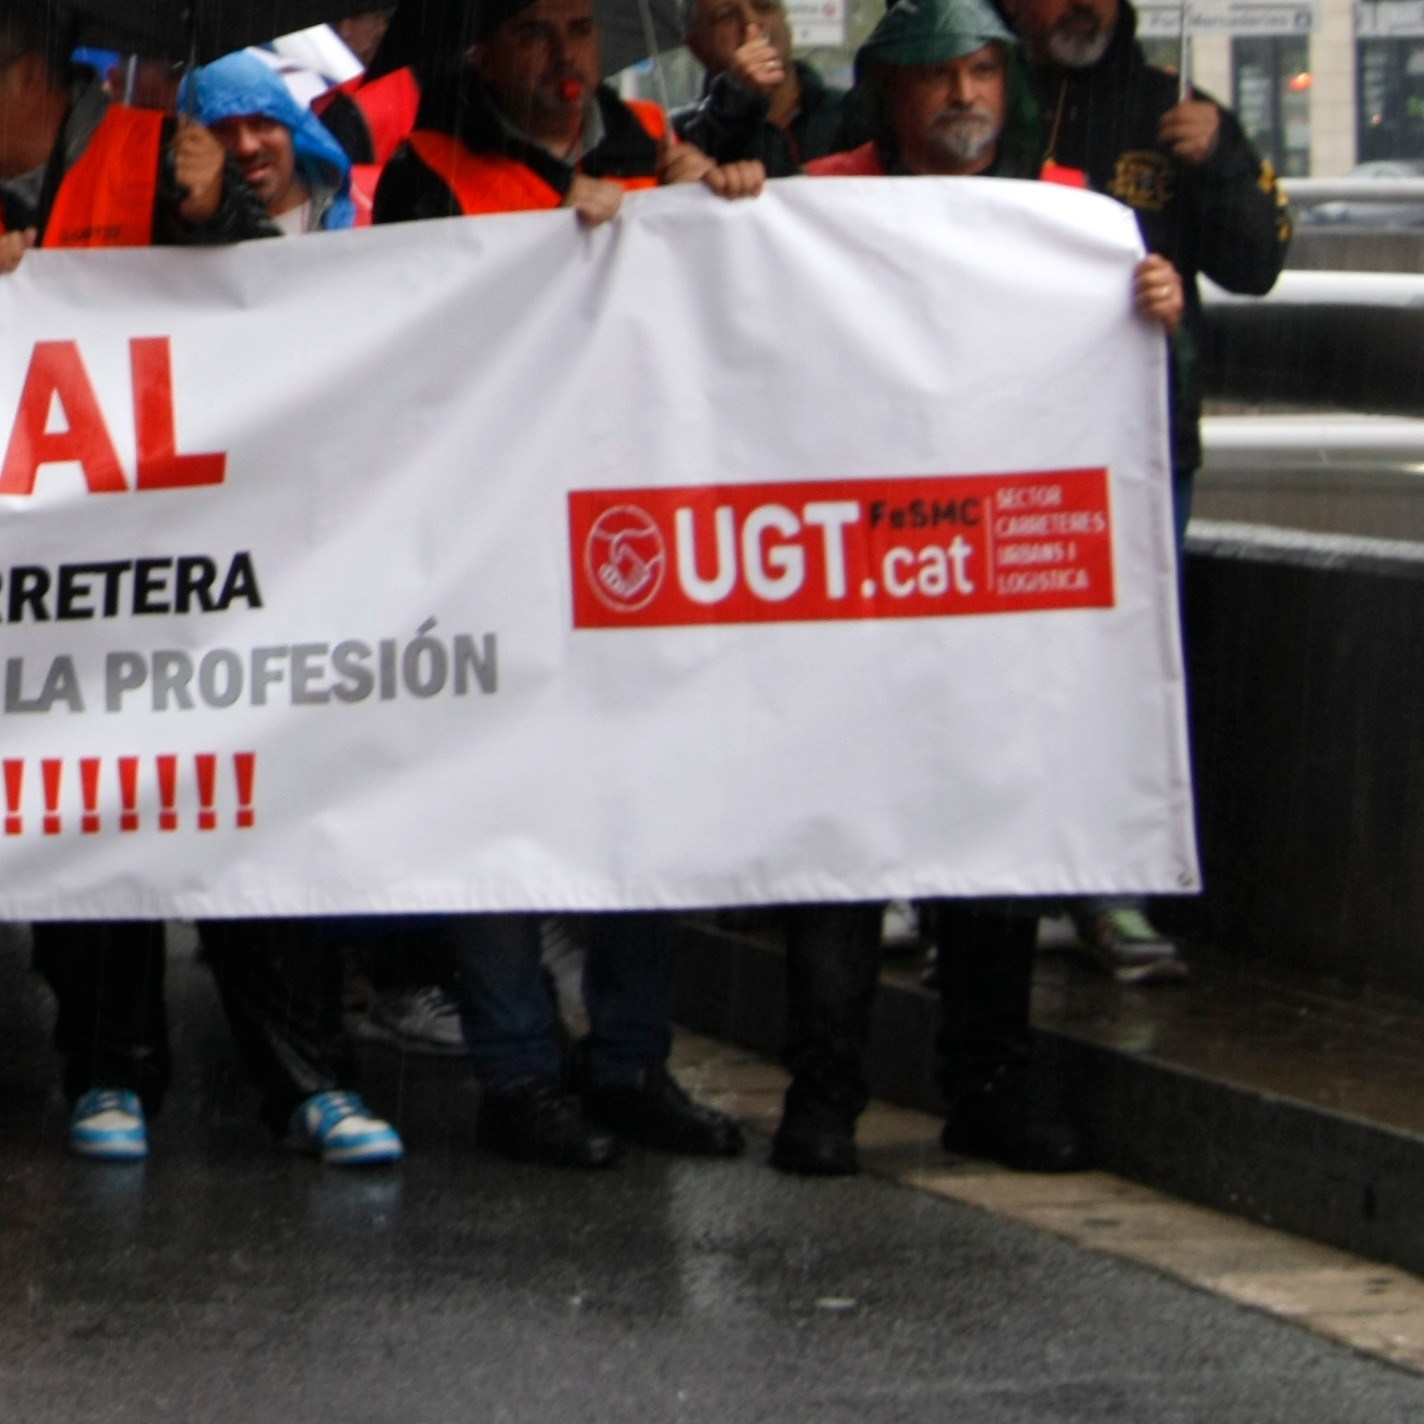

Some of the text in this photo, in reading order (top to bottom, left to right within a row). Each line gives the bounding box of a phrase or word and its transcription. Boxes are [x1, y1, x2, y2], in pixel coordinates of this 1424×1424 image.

[996, 485, 1062, 508] SECTOR
[870, 499, 981, 529] FeSMC
[995, 511, 1106, 536] CARRETERES
[4, 655, 84, 714] LA
[106, 616, 498, 712] PROFESIÓN
[4, 753, 255, 836] !!!!!!!
